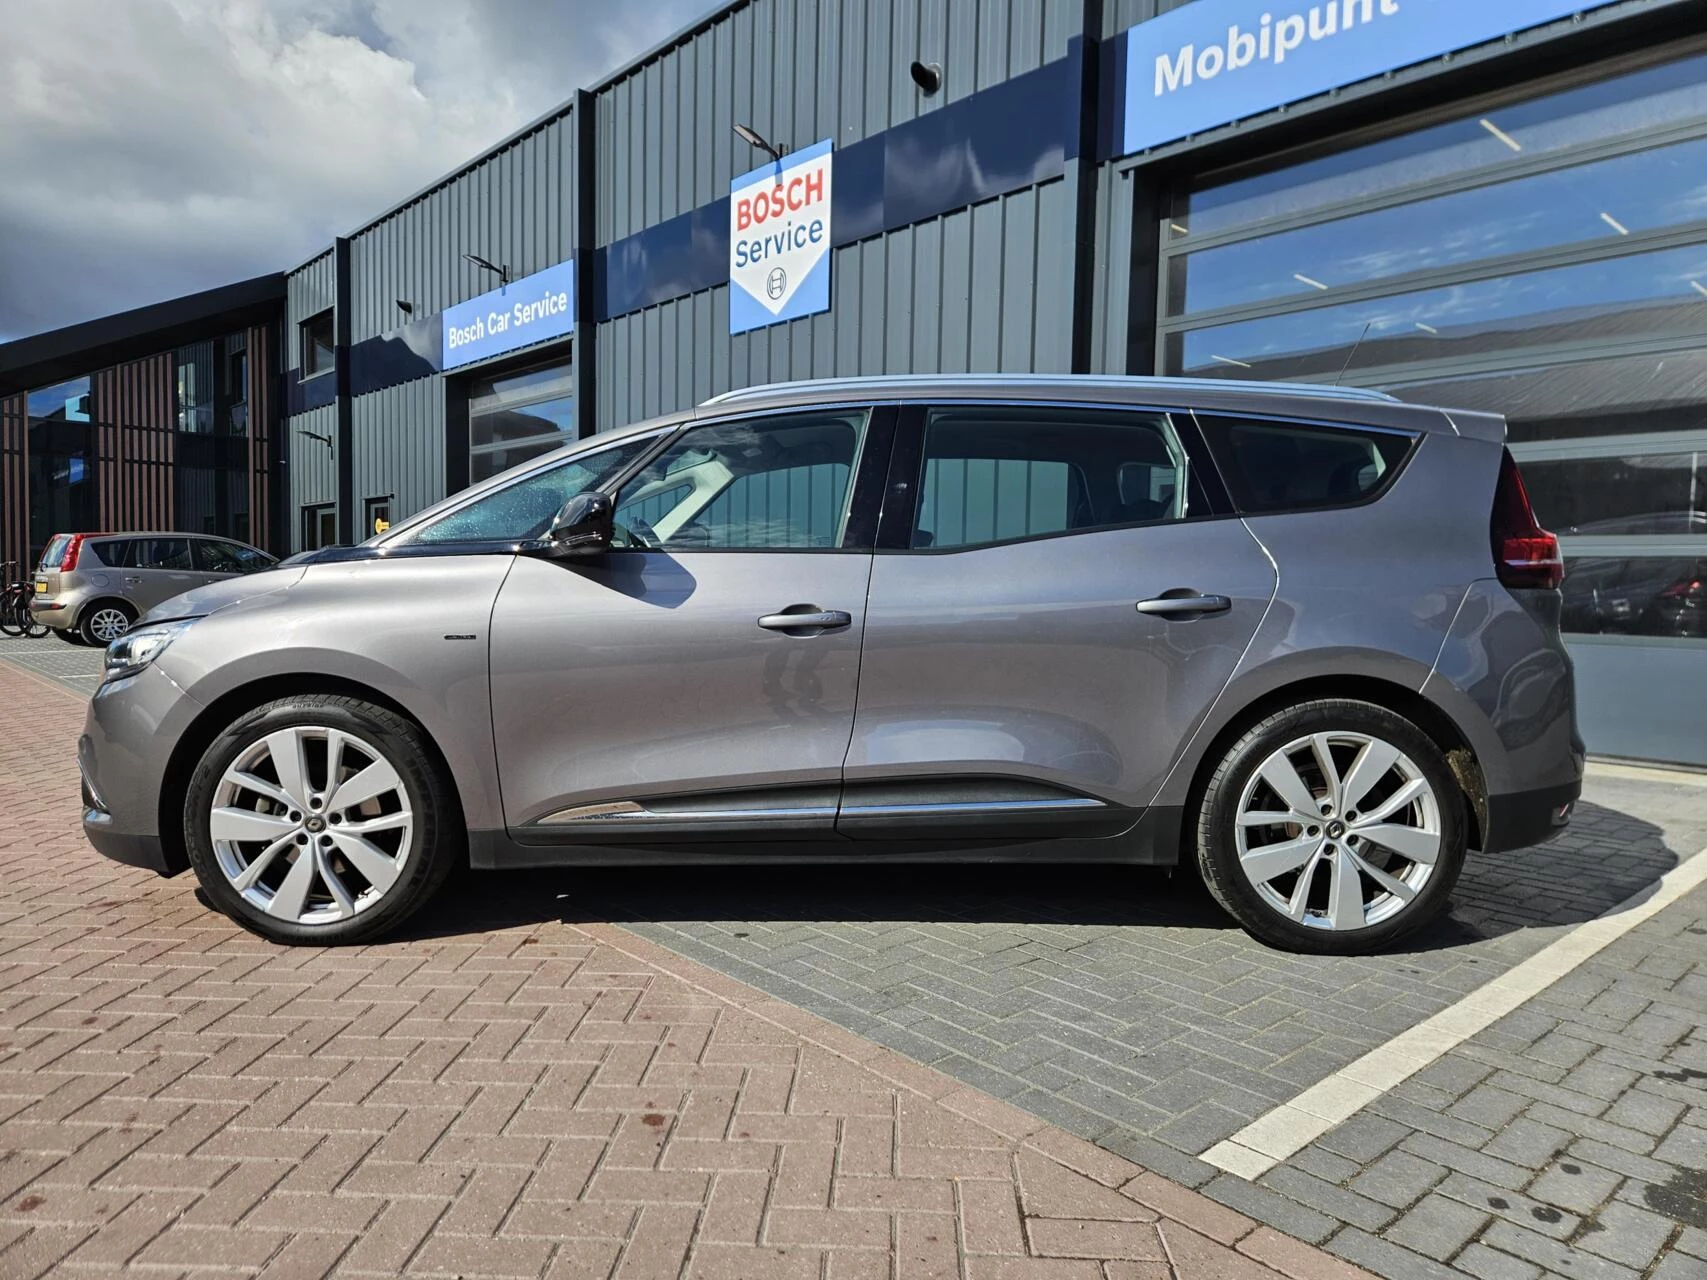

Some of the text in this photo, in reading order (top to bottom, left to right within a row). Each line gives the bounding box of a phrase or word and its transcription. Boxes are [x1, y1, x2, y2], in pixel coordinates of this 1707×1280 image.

[737, 167, 823, 232] BOSCH
[735, 218, 823, 268] Service
[448, 290, 568, 350] Bosch Car Service
